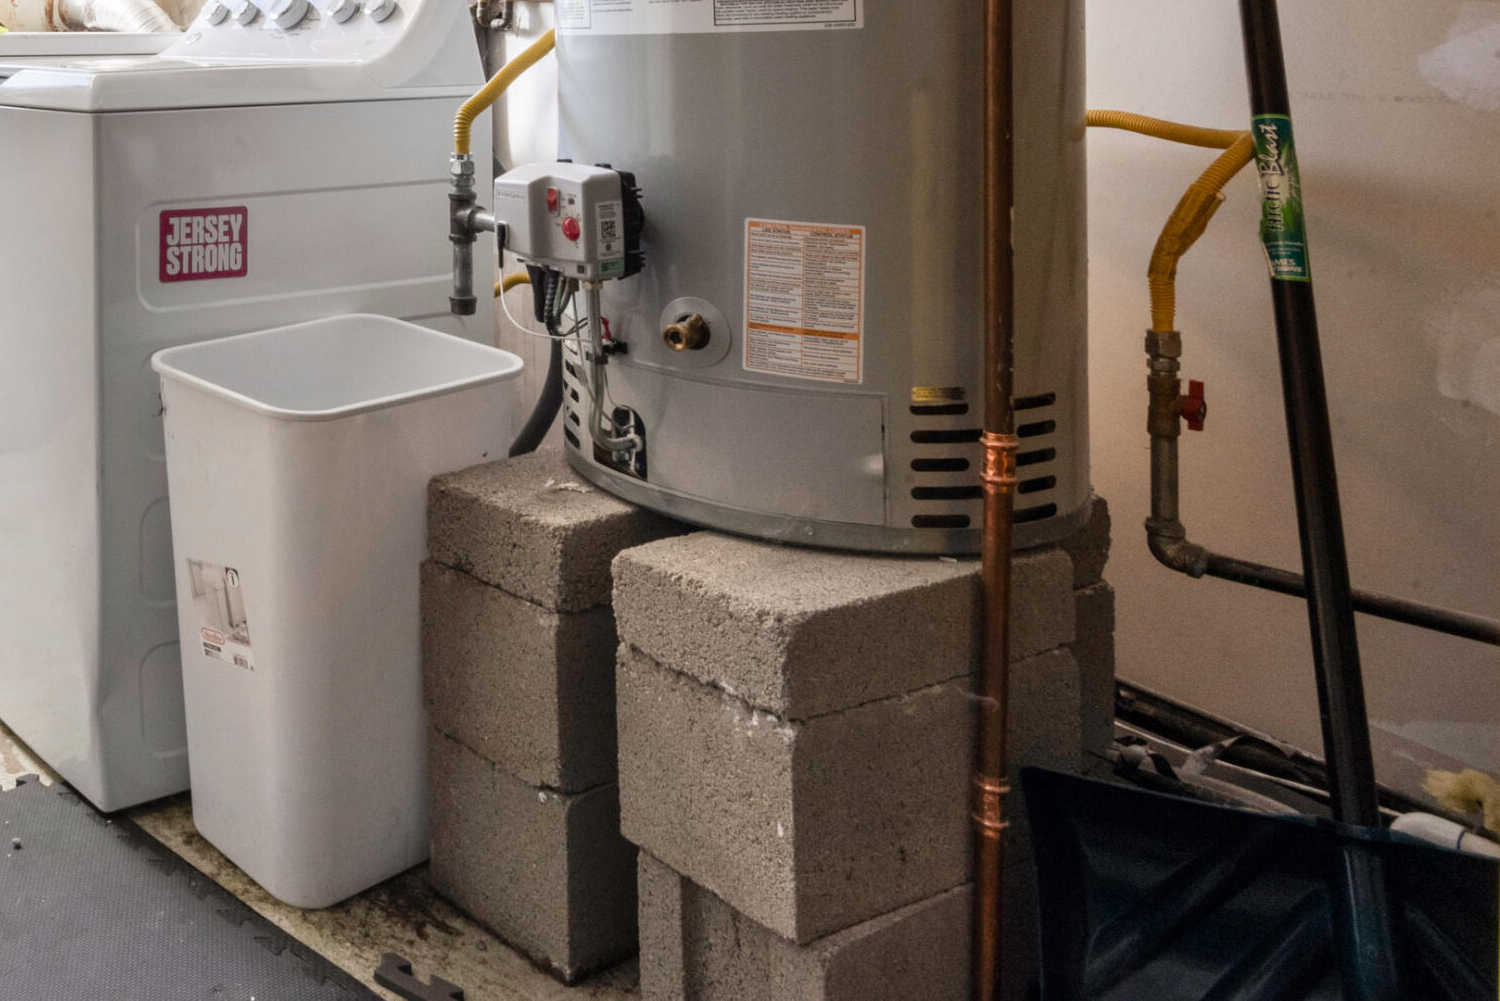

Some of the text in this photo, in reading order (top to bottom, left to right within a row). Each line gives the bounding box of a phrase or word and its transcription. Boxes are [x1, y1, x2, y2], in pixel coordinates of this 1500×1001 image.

[1259, 123, 1285, 176] Blast
[166, 213, 243, 246] JERSEY
[166, 242, 243, 276] STRONG
